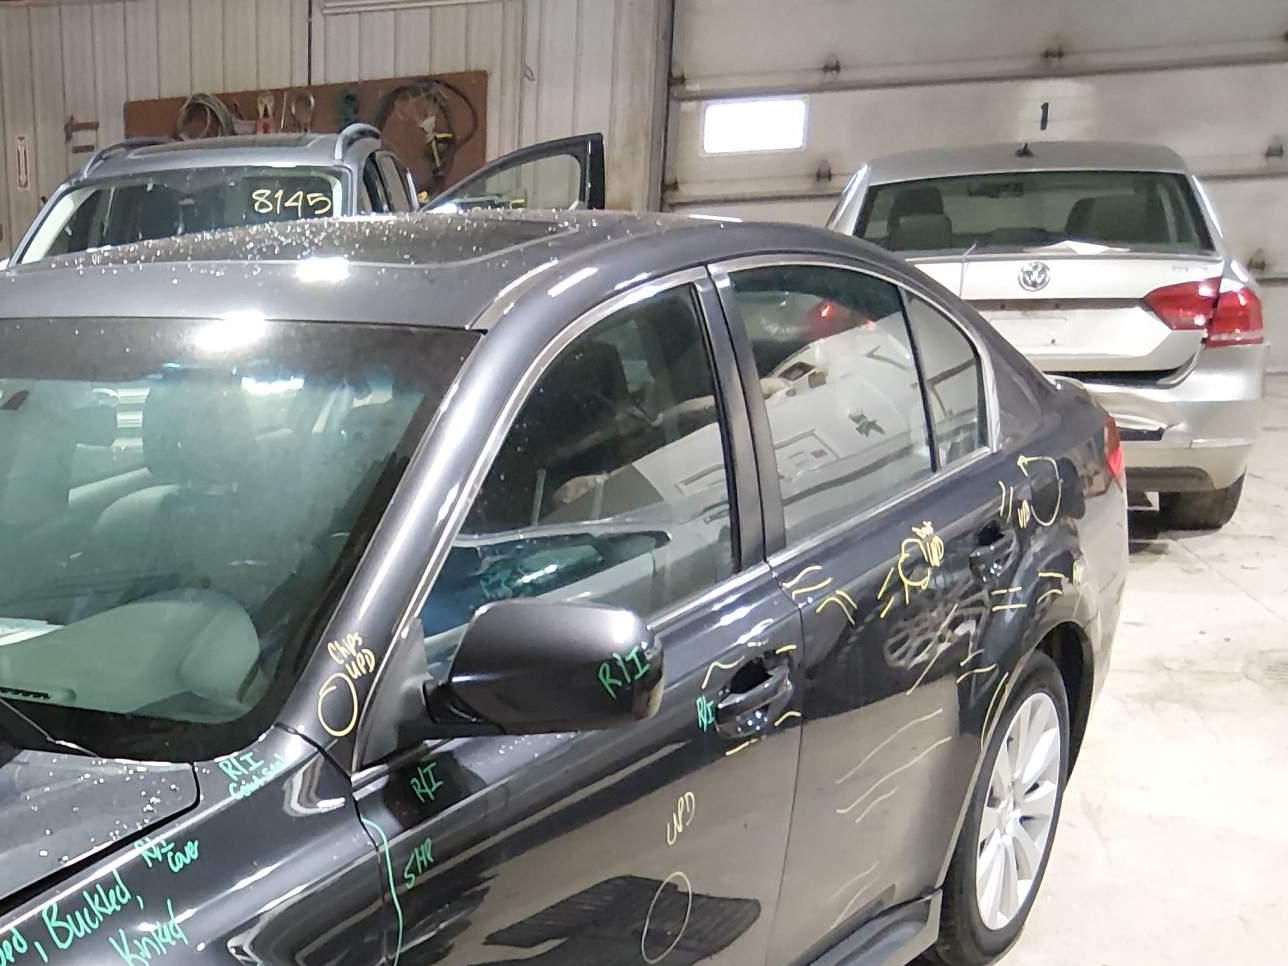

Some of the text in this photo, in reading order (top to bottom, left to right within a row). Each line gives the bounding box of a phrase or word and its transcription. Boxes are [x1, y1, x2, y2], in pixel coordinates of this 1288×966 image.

[1040, 102, 1050, 131] 1
[252, 189, 332, 218] 8145
[598, 646, 650, 700] R/I
[218, 751, 265, 781] R/I
[409, 761, 444, 803] R/I
